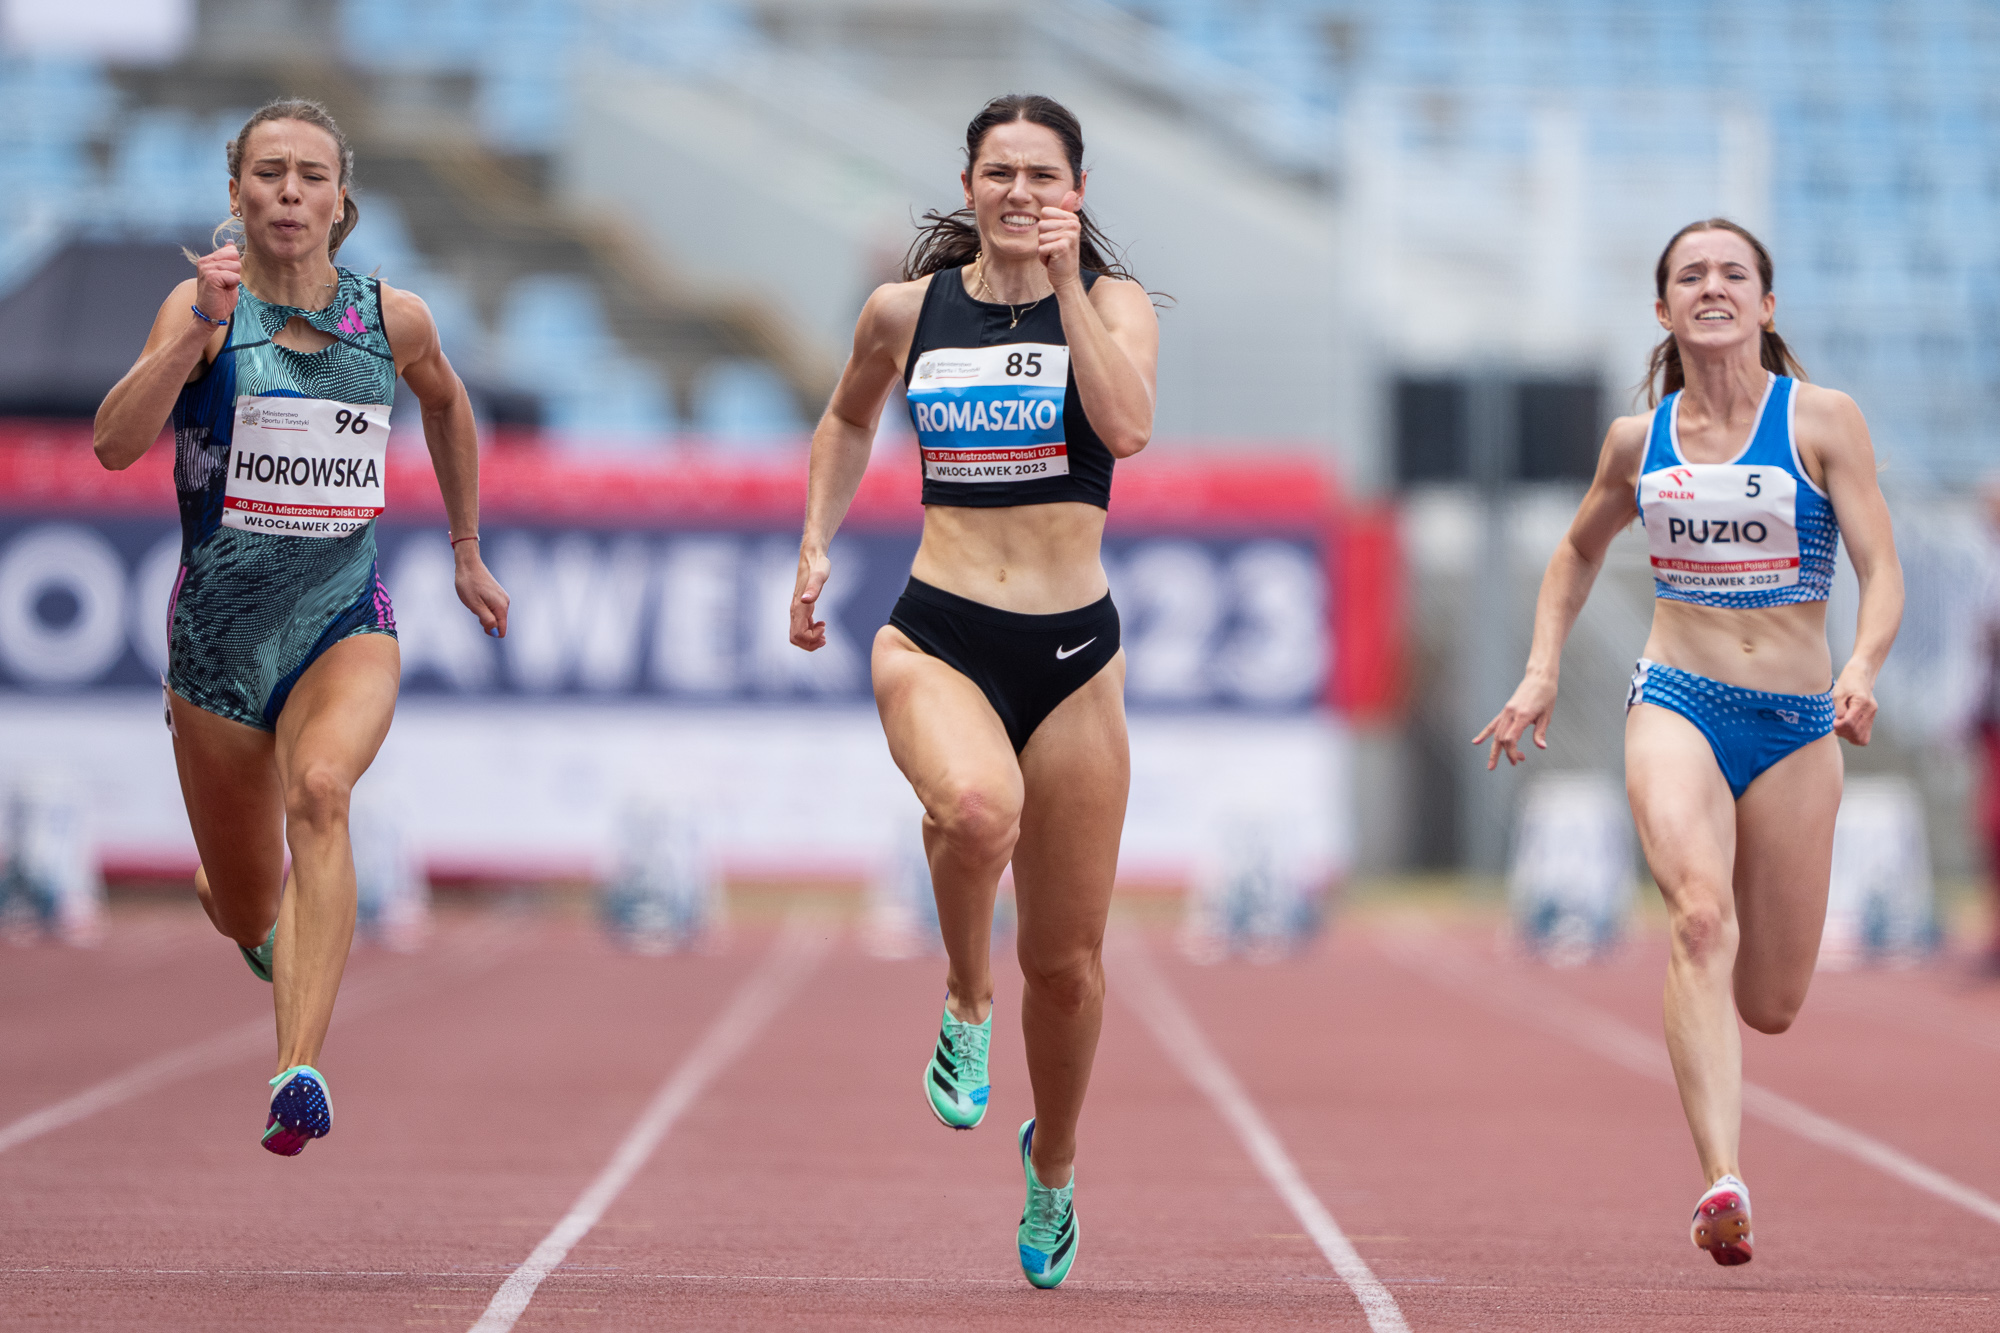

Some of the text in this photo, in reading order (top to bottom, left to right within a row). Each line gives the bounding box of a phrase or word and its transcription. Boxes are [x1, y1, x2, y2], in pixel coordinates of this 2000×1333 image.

[1005, 352, 1042, 377] 85
[261, 417, 280, 425] Sportu
[284, 418, 310, 426] Turystyki
[262, 410, 299, 418] Ministerstwo
[335, 409, 369, 435] 96
[915, 399, 1057, 432] ROMASZKO
[957, 451, 1009, 462] Mistrzostwa
[1010, 449, 1037, 460] Polski
[1038, 447, 1057, 458] U23
[234, 450, 380, 488] HOROWSKA
[936, 462, 1047, 477] WŁOCŁAWEK 2023
[1658, 490, 1695, 500] ORLEN
[1745, 474, 1761, 498] 5
[235, 499, 375, 518] 40. PZLA Mistrzostwa Polski U23
[243, 515, 363, 532] WŁOCŁAWEK 202
[1668, 516, 1767, 544] PUZIO
[1667, 573, 1780, 587] WŁOCŁAWEK 2023
